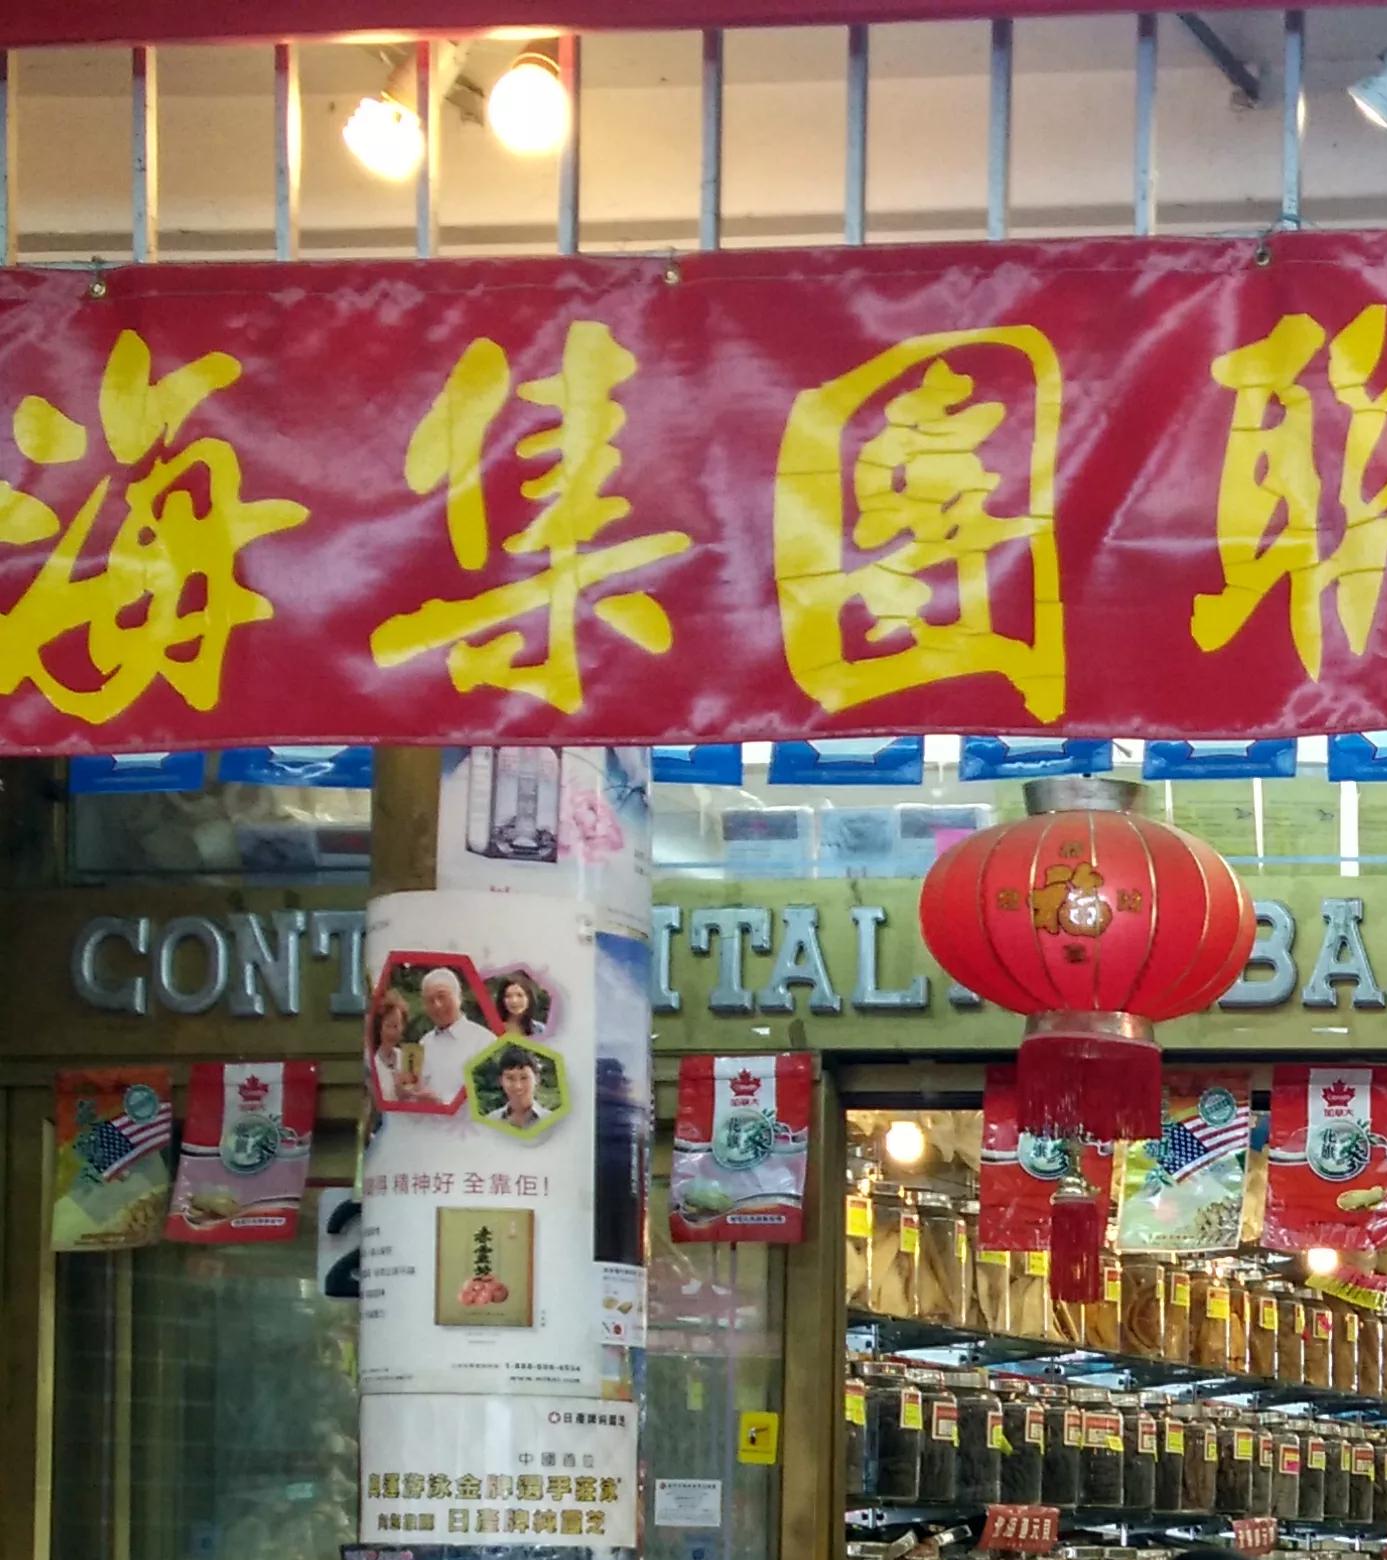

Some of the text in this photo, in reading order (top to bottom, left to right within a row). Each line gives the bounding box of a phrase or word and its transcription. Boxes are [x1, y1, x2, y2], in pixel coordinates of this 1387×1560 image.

[1030, 862, 1113, 938] 福
[73, 903, 928, 1016] CONTTAL
[392, 1171, 455, 1196] 精神好
